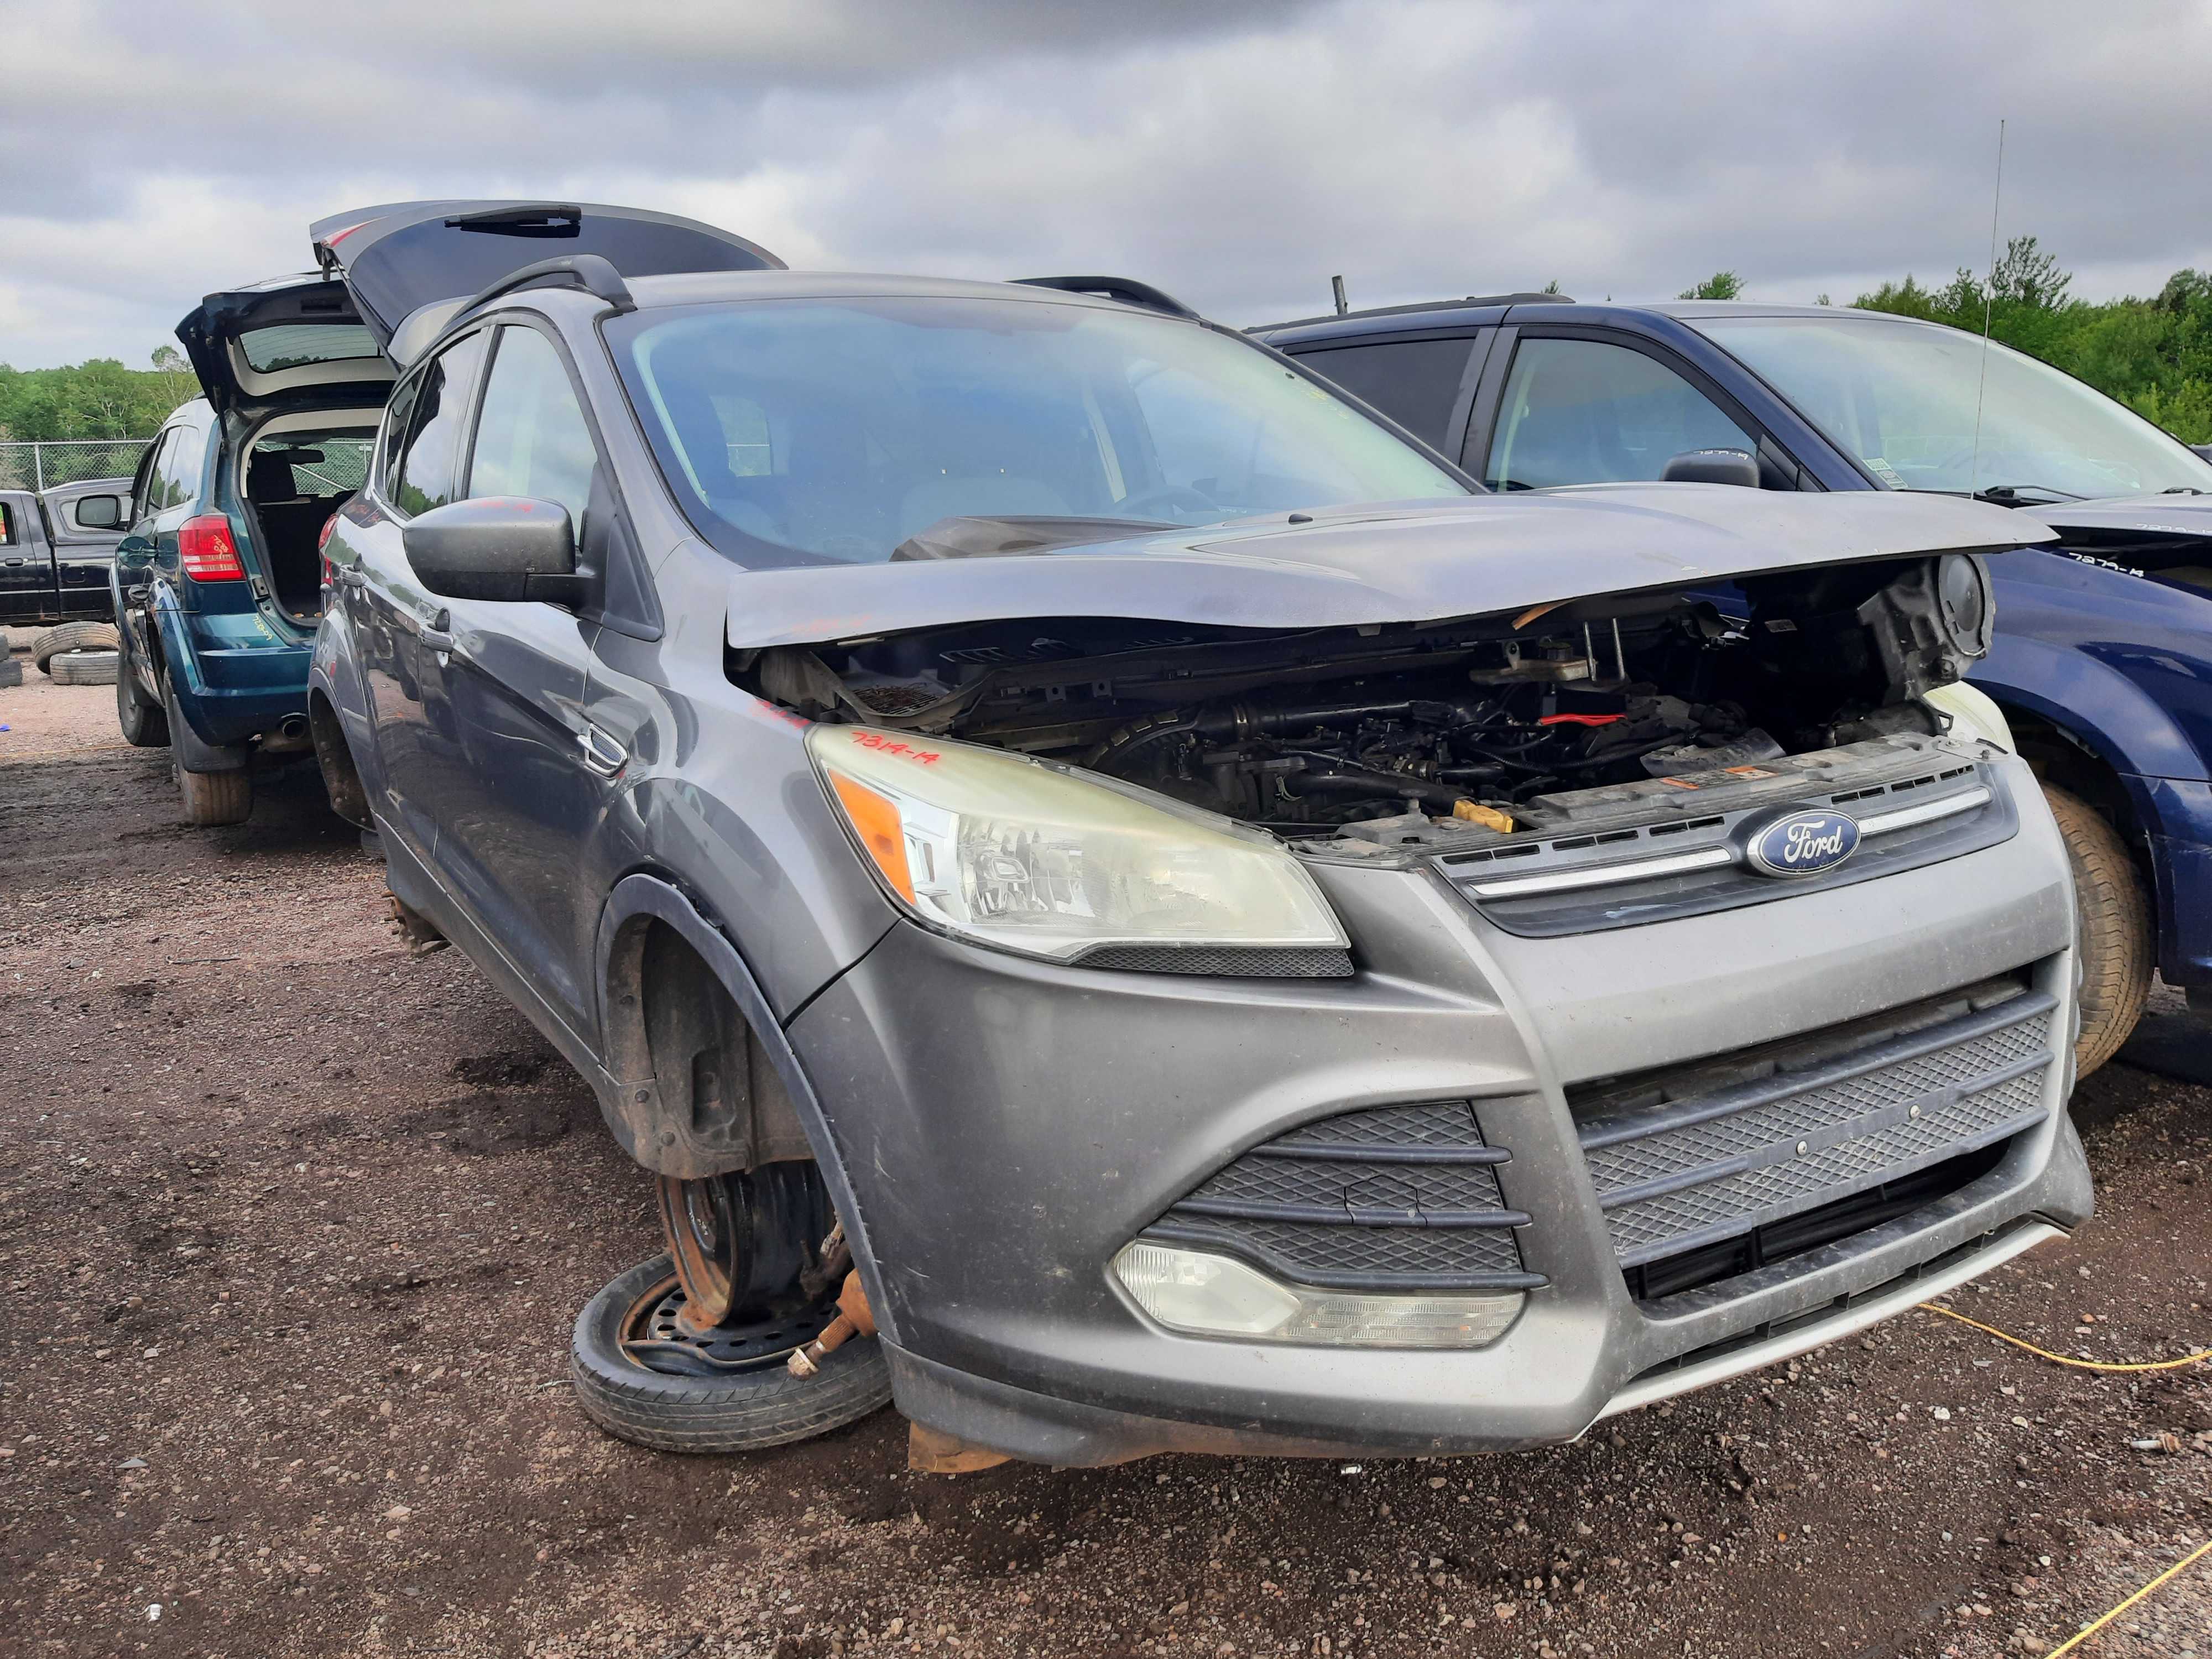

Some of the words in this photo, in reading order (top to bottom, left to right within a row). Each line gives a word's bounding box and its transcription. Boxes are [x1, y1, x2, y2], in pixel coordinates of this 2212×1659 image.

[2069, 552, 2145, 578] 7279-14
[852, 731, 940, 764] 7314-14
[1784, 820, 1843, 863] Ford
